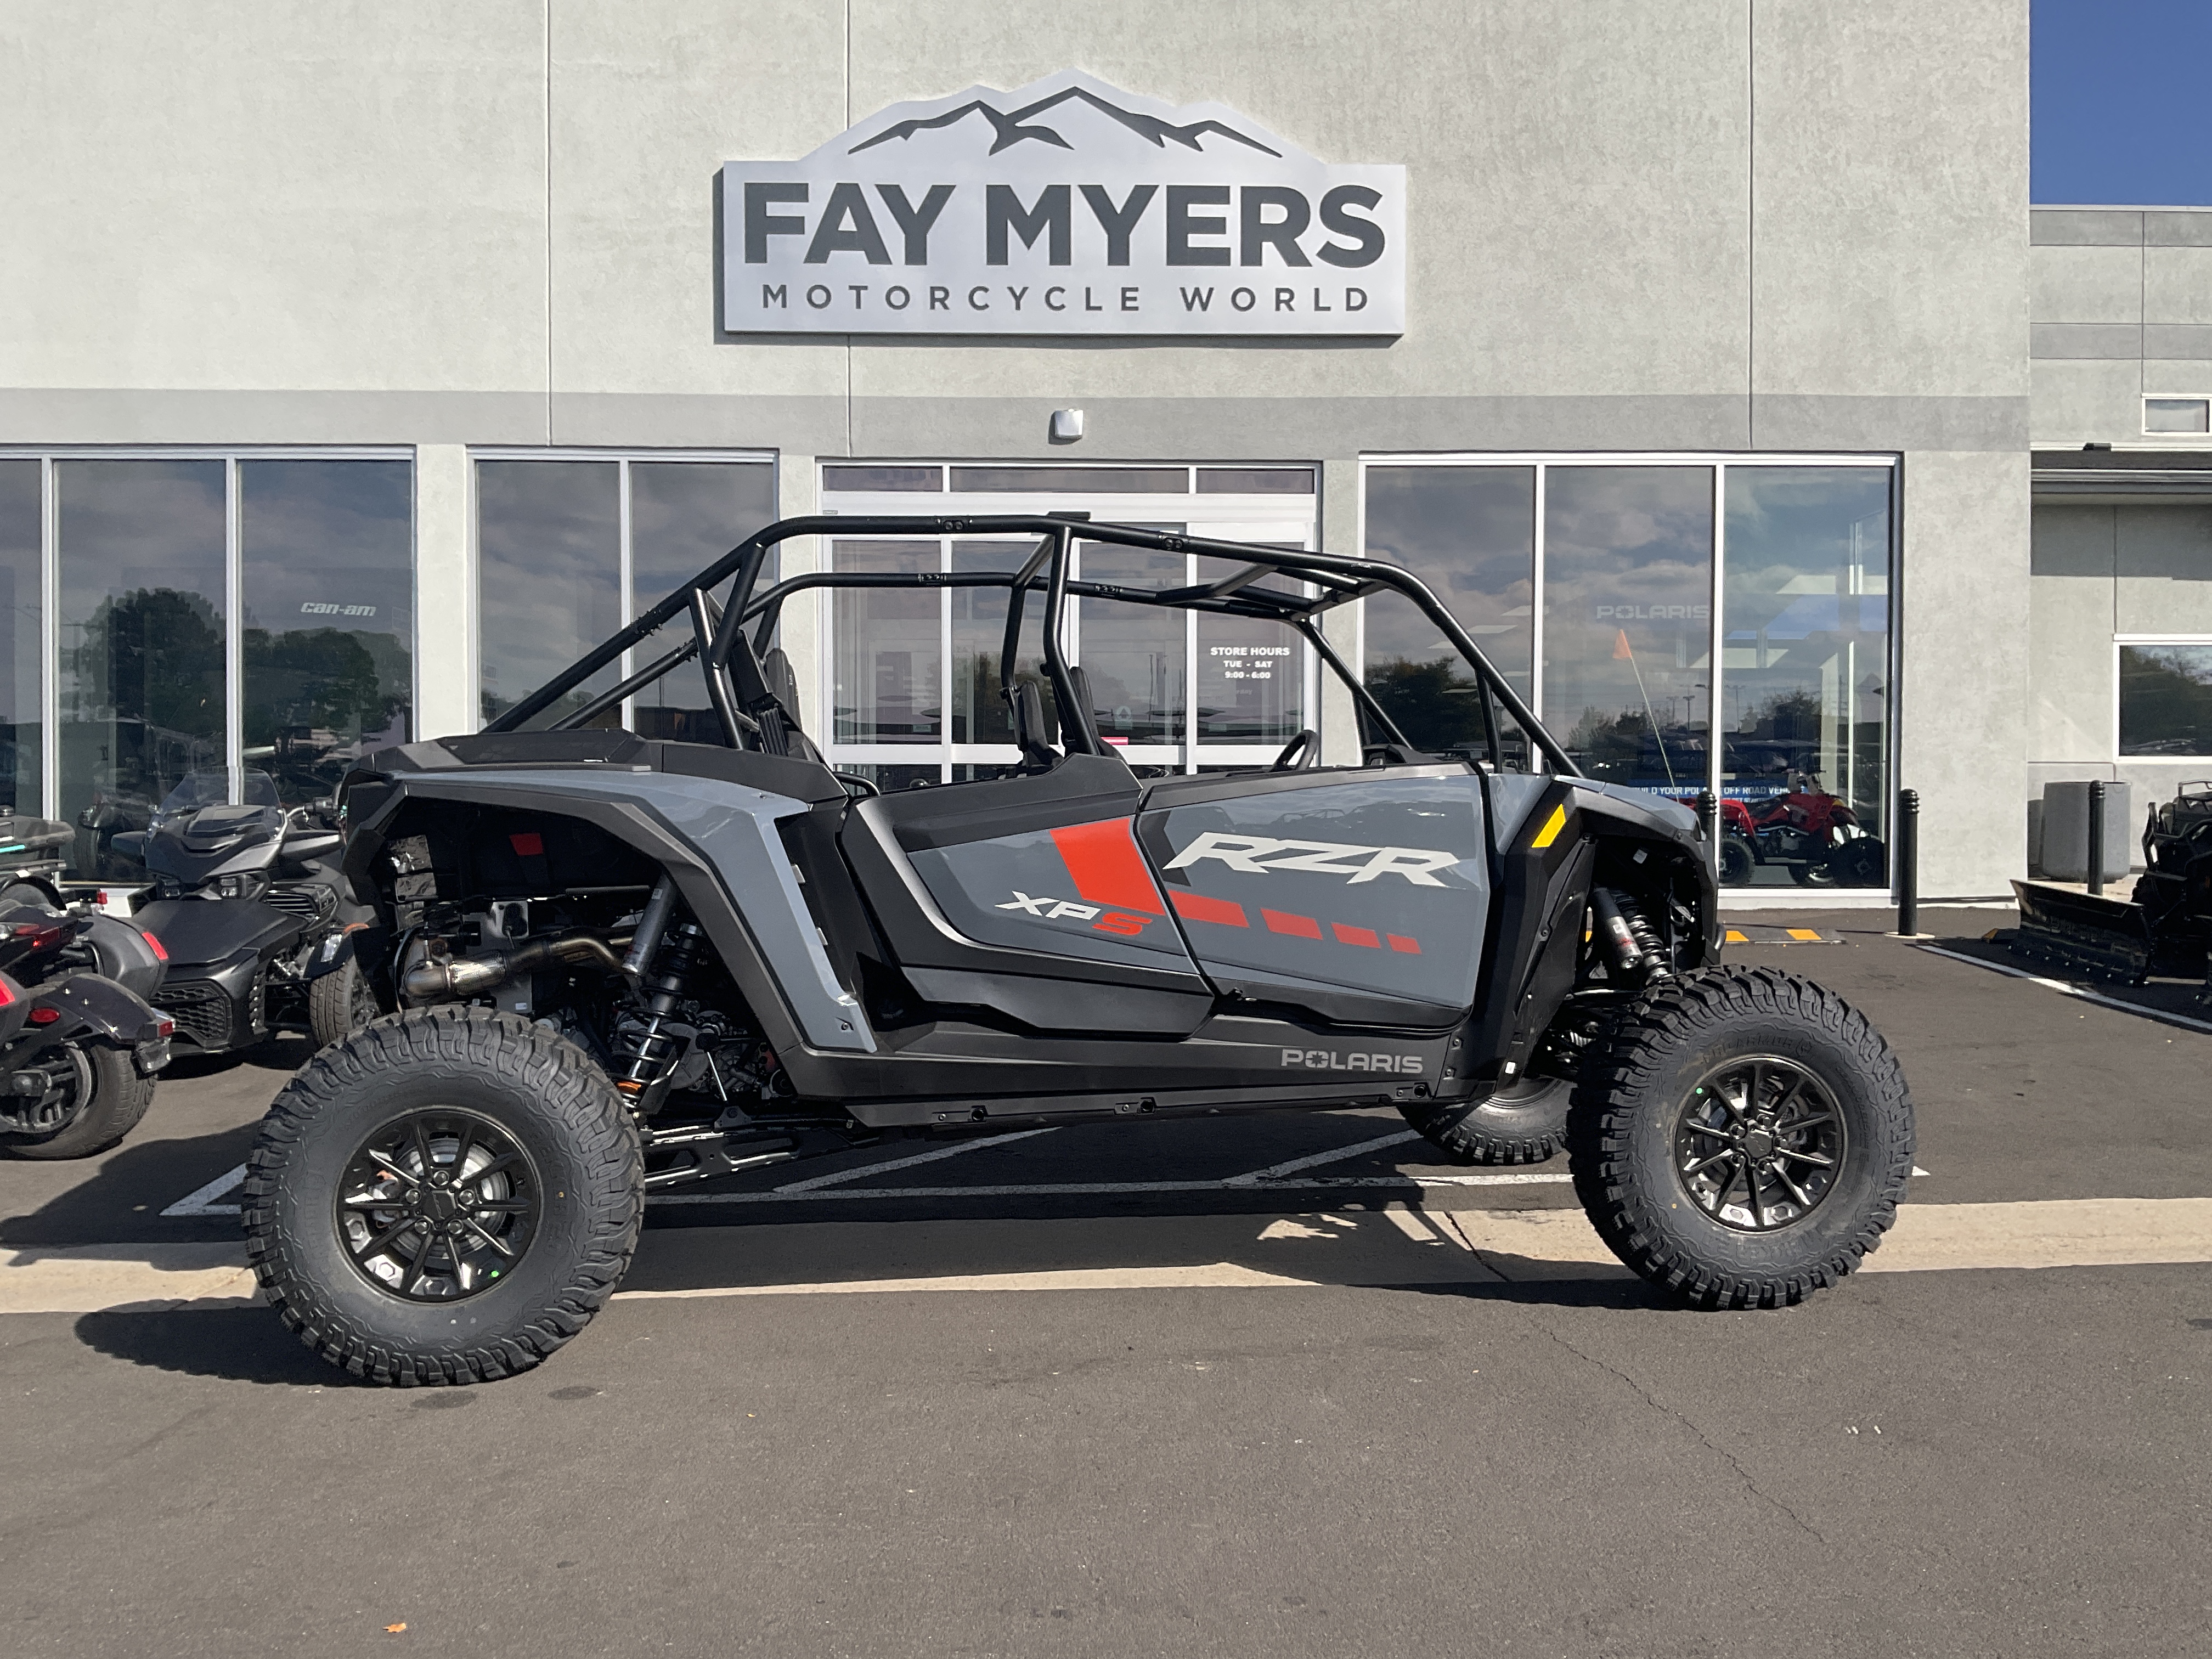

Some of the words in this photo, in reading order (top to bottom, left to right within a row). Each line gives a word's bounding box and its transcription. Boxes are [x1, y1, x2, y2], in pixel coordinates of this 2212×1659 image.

[744, 182, 956, 266] FAY
[986, 184, 1385, 268] MYERS
[763, 285, 1139, 312] MOTORCYCLE
[1180, 287, 1368, 312] WORLD
[301, 602, 376, 616] can-am
[1596, 605, 1709, 619] POLARIS
[1210, 647, 1248, 656] STORE
[1250, 647, 1290, 656] HOURS
[1742, 786, 1767, 794] ROAD
[1163, 832, 1460, 888] RZR
[1281, 1049, 1423, 1074] POLARIS
